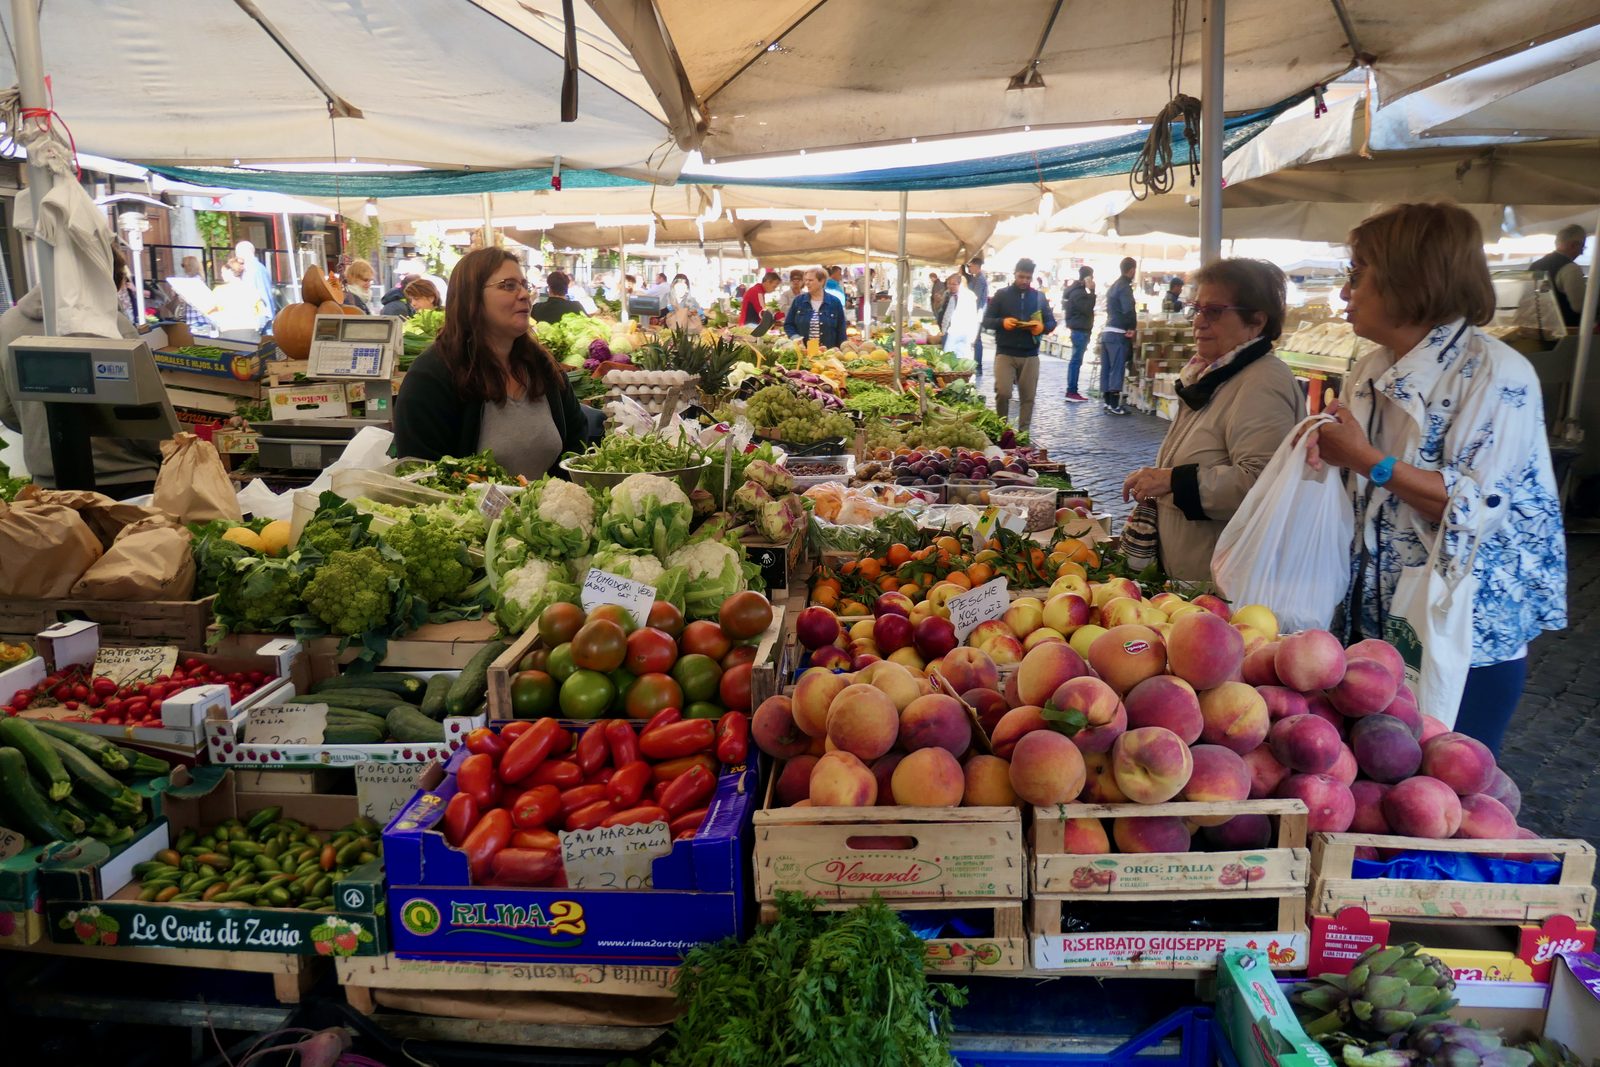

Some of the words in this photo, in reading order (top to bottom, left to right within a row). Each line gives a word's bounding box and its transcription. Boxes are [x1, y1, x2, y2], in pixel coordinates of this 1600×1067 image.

[588, 570, 632, 591] POMODORI
[948, 586, 998, 613] PESCHE
[958, 608, 981, 621] NOCI
[97, 647, 162, 657] DATTERINO
[357, 764, 422, 775] POMODOR
[563, 832, 595, 849] SAN
[600, 823, 666, 840] MARZANO
[566, 847, 616, 862] EXTRA
[626, 839, 667, 851] ITALIA
[825, 860, 922, 883] Verardi
[1167, 863, 1214, 874] ITALIA
[129, 913, 159, 940] Le
[161, 914, 215, 944] Corti
[217, 918, 241, 944] di
[244, 918, 303, 947] Zevio
[1063, 937, 1146, 952] RISERBATO
[1149, 936, 1227, 952] GIUSEPPE
[1531, 937, 1586, 965] Elite
